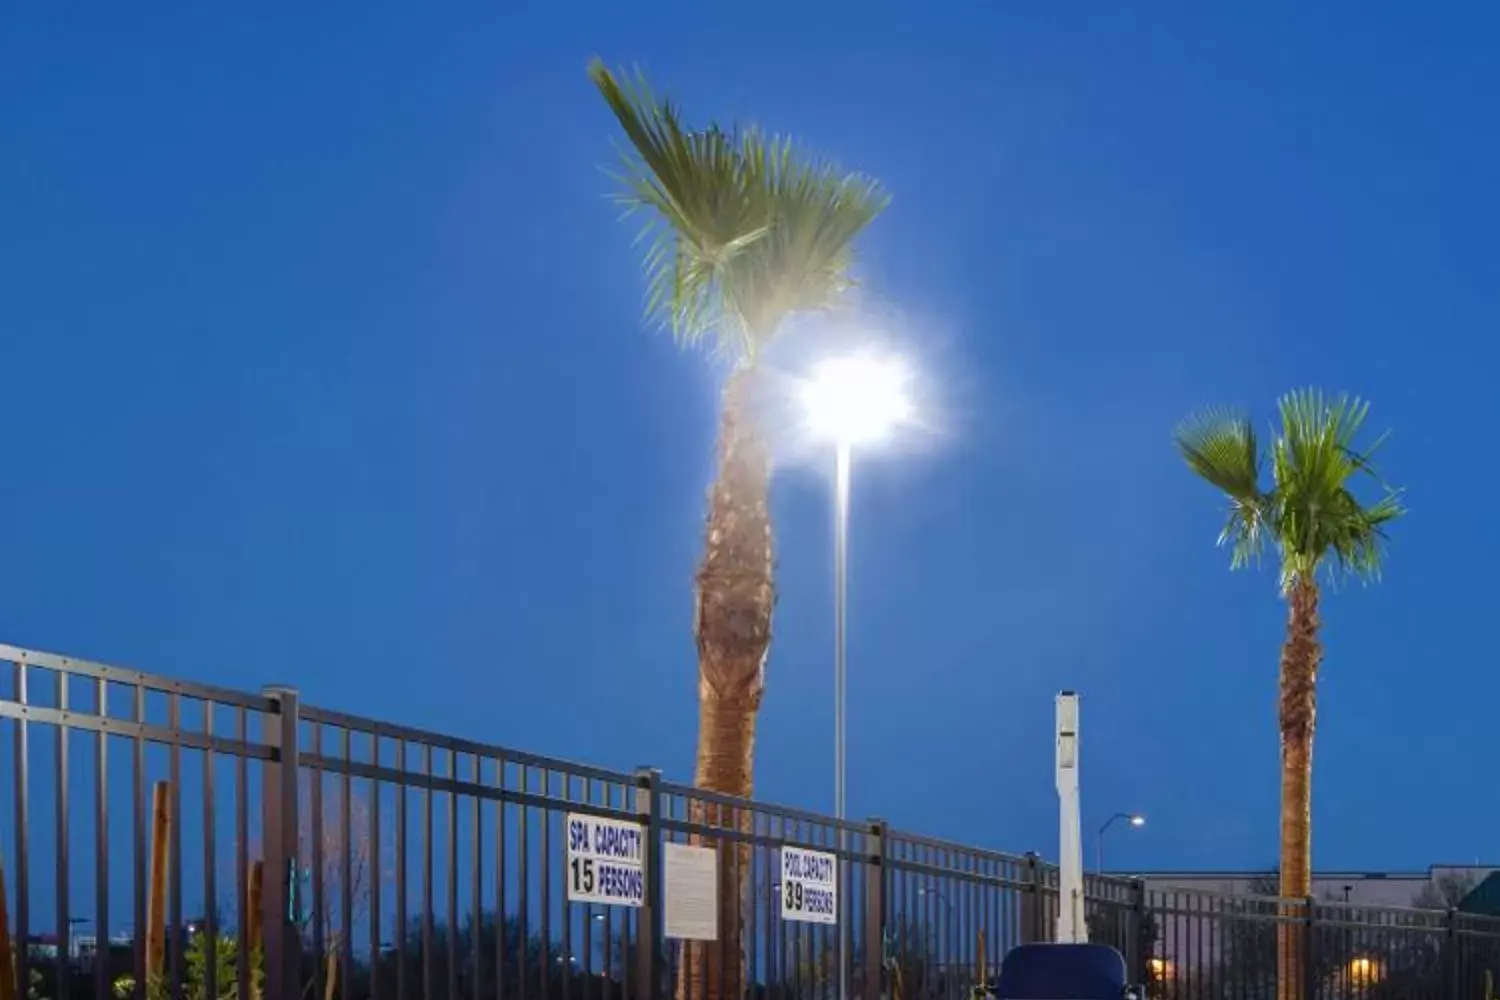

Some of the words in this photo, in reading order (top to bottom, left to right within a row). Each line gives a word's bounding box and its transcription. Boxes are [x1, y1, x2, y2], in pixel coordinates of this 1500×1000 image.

[571, 818, 590, 852] SPA
[595, 823, 641, 859] CAPACITY
[571, 857, 594, 892] 15
[598, 866, 642, 899] PERSONS
[785, 852, 802, 878] POOL
[803, 855, 833, 882] CAPACITY
[785, 880, 802, 911] 39
[804, 888, 833, 914] PERSONS
